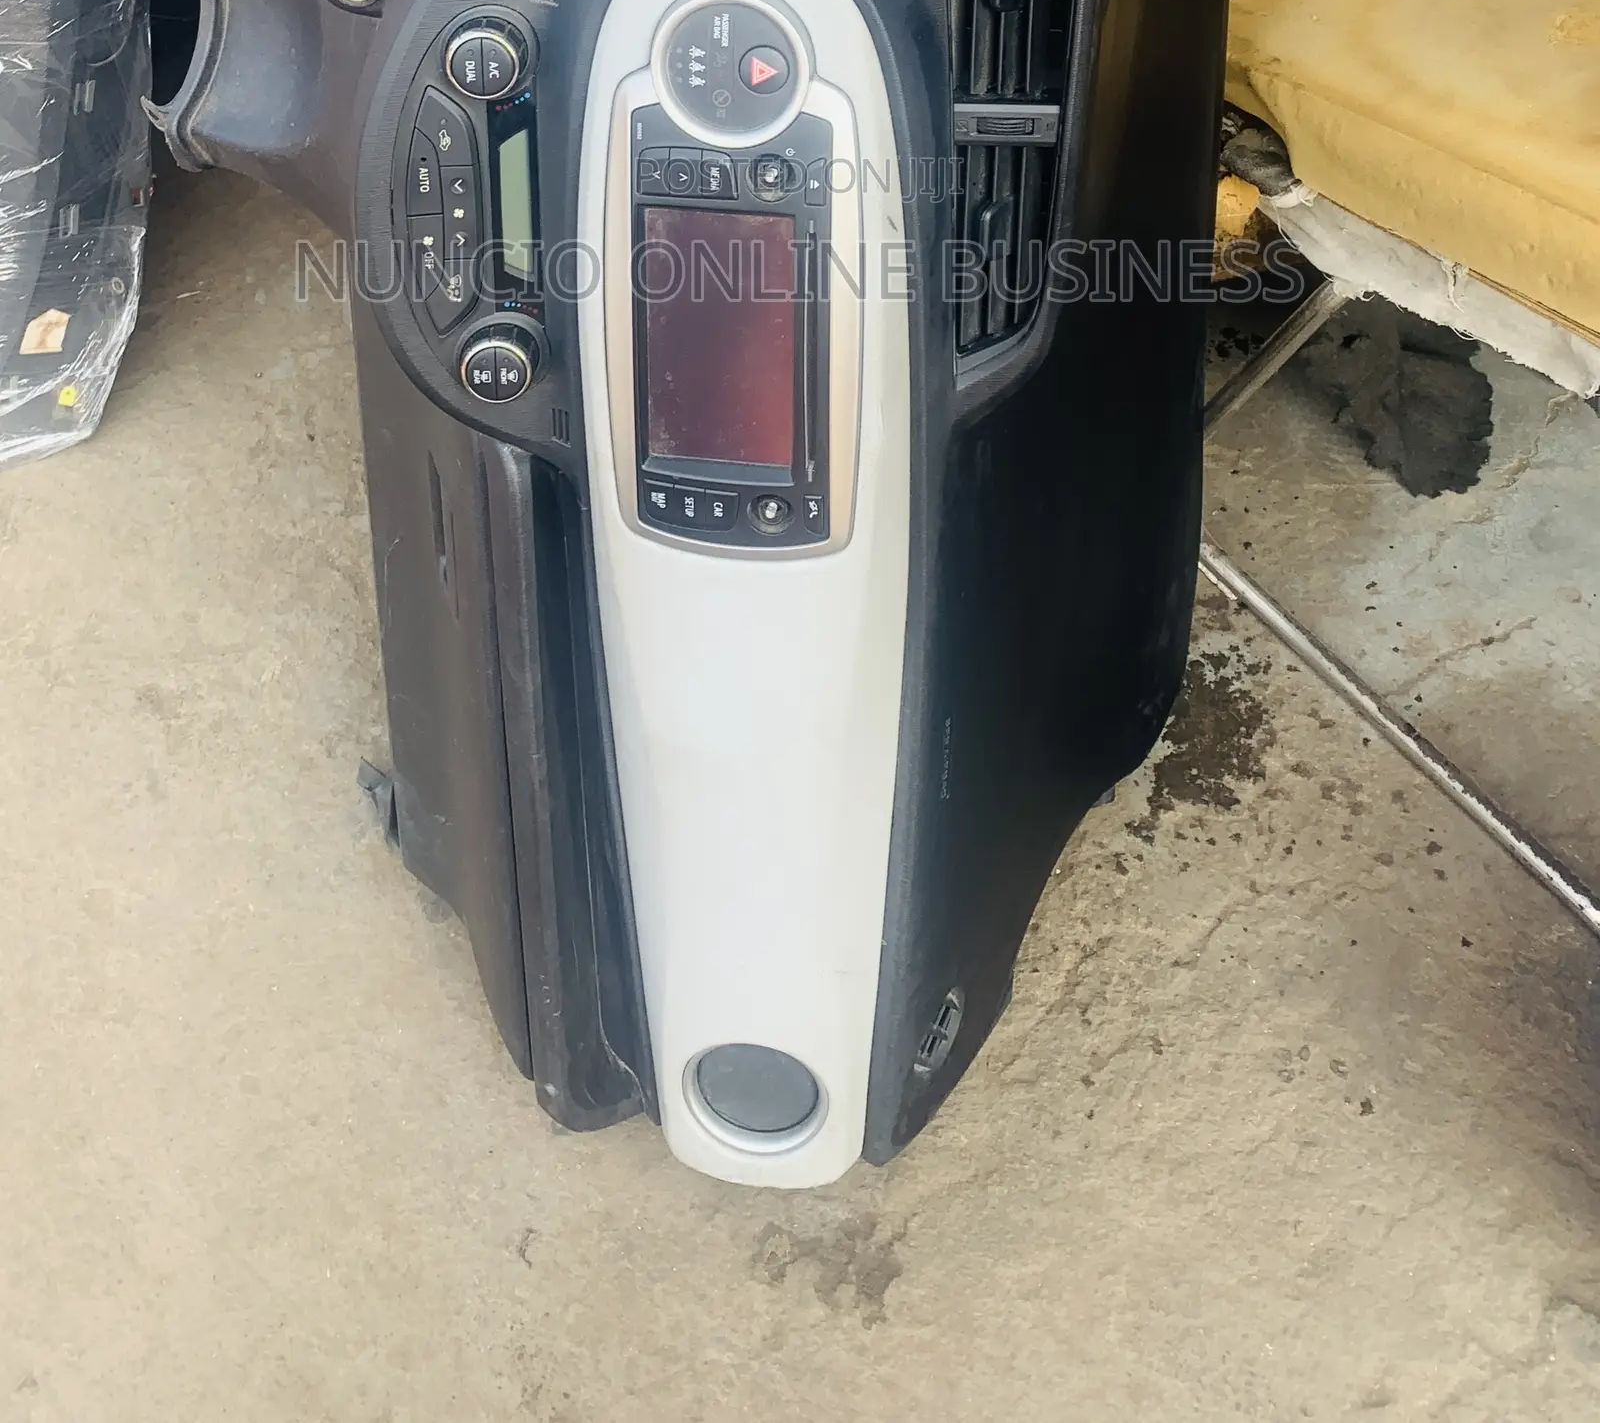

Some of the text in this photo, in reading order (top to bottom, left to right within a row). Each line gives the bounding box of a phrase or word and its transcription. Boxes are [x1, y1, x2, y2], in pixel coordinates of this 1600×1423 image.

[721, 13, 730, 48] PASSENGER
[465, 60, 477, 84] DUAL
[488, 61, 500, 79] A/C
[418, 167, 430, 193] AUTO
[710, 166, 720, 191] MEDIA
[423, 251, 435, 270] OFF
[658, 492, 666, 509] MAP
[684, 496, 695, 518] SETUP
[713, 502, 724, 518] CAR
